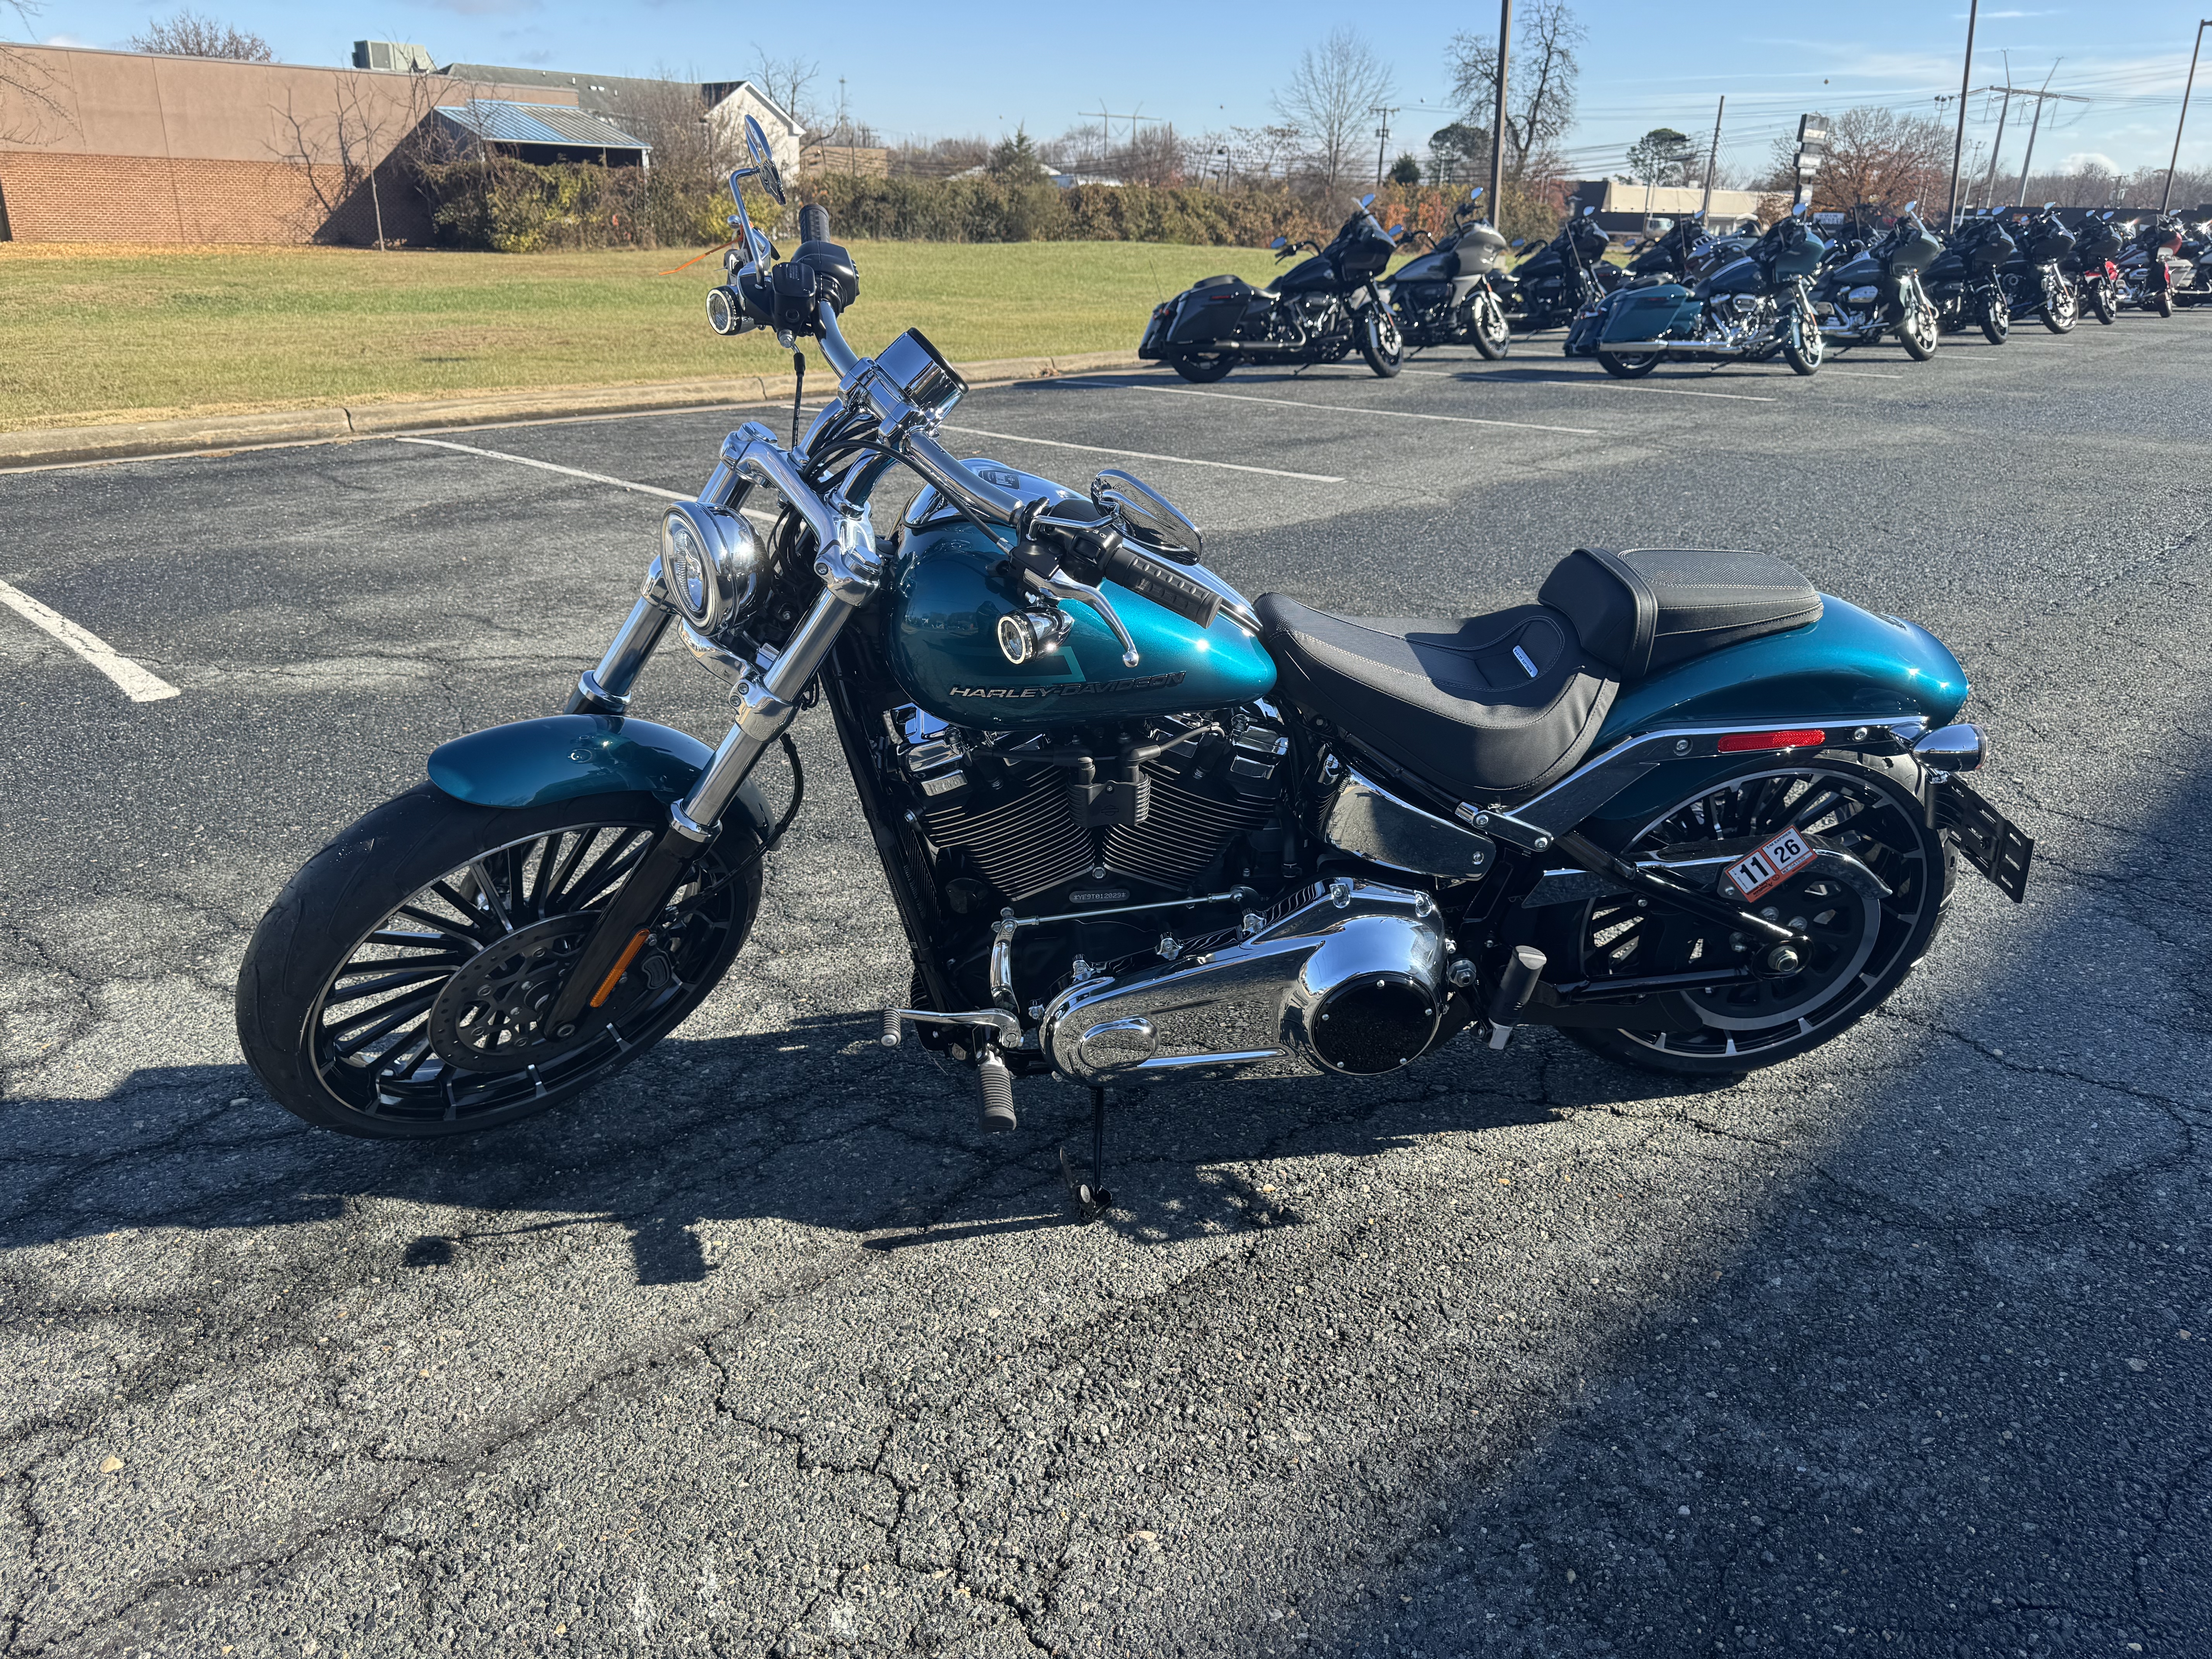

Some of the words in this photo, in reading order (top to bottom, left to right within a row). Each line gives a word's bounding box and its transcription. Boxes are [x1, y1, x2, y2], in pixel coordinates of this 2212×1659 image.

[949, 671, 1186, 697] HARLEY-DAVIDSON
[1774, 831, 1791, 844] EXPIRES
[1774, 839, 1800, 864] 26
[1740, 856, 1769, 884] 11
